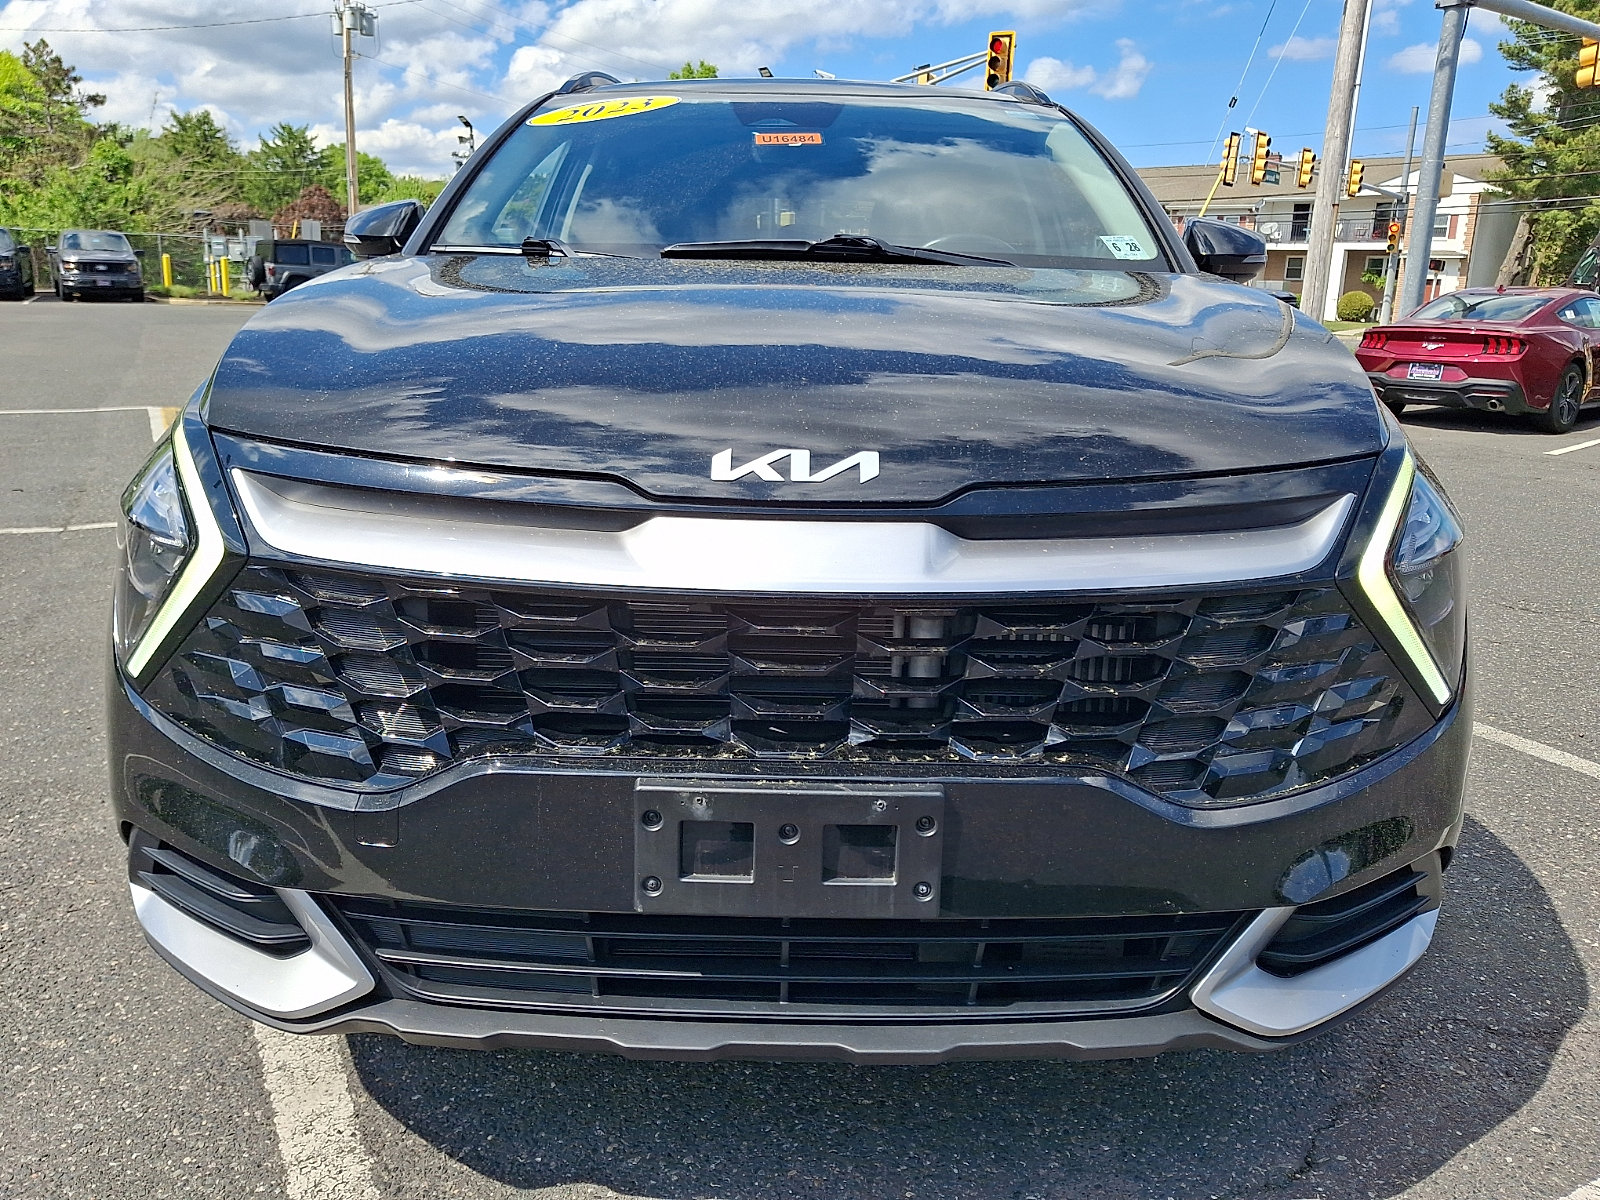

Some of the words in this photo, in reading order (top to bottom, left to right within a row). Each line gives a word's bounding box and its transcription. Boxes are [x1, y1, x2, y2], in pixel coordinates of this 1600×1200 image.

[556, 98, 653, 122] 2023
[762, 135, 815, 143] U16484
[1112, 242, 1121, 252] 6
[1125, 242, 1141, 252] 28
[711, 448, 880, 484] KIA
